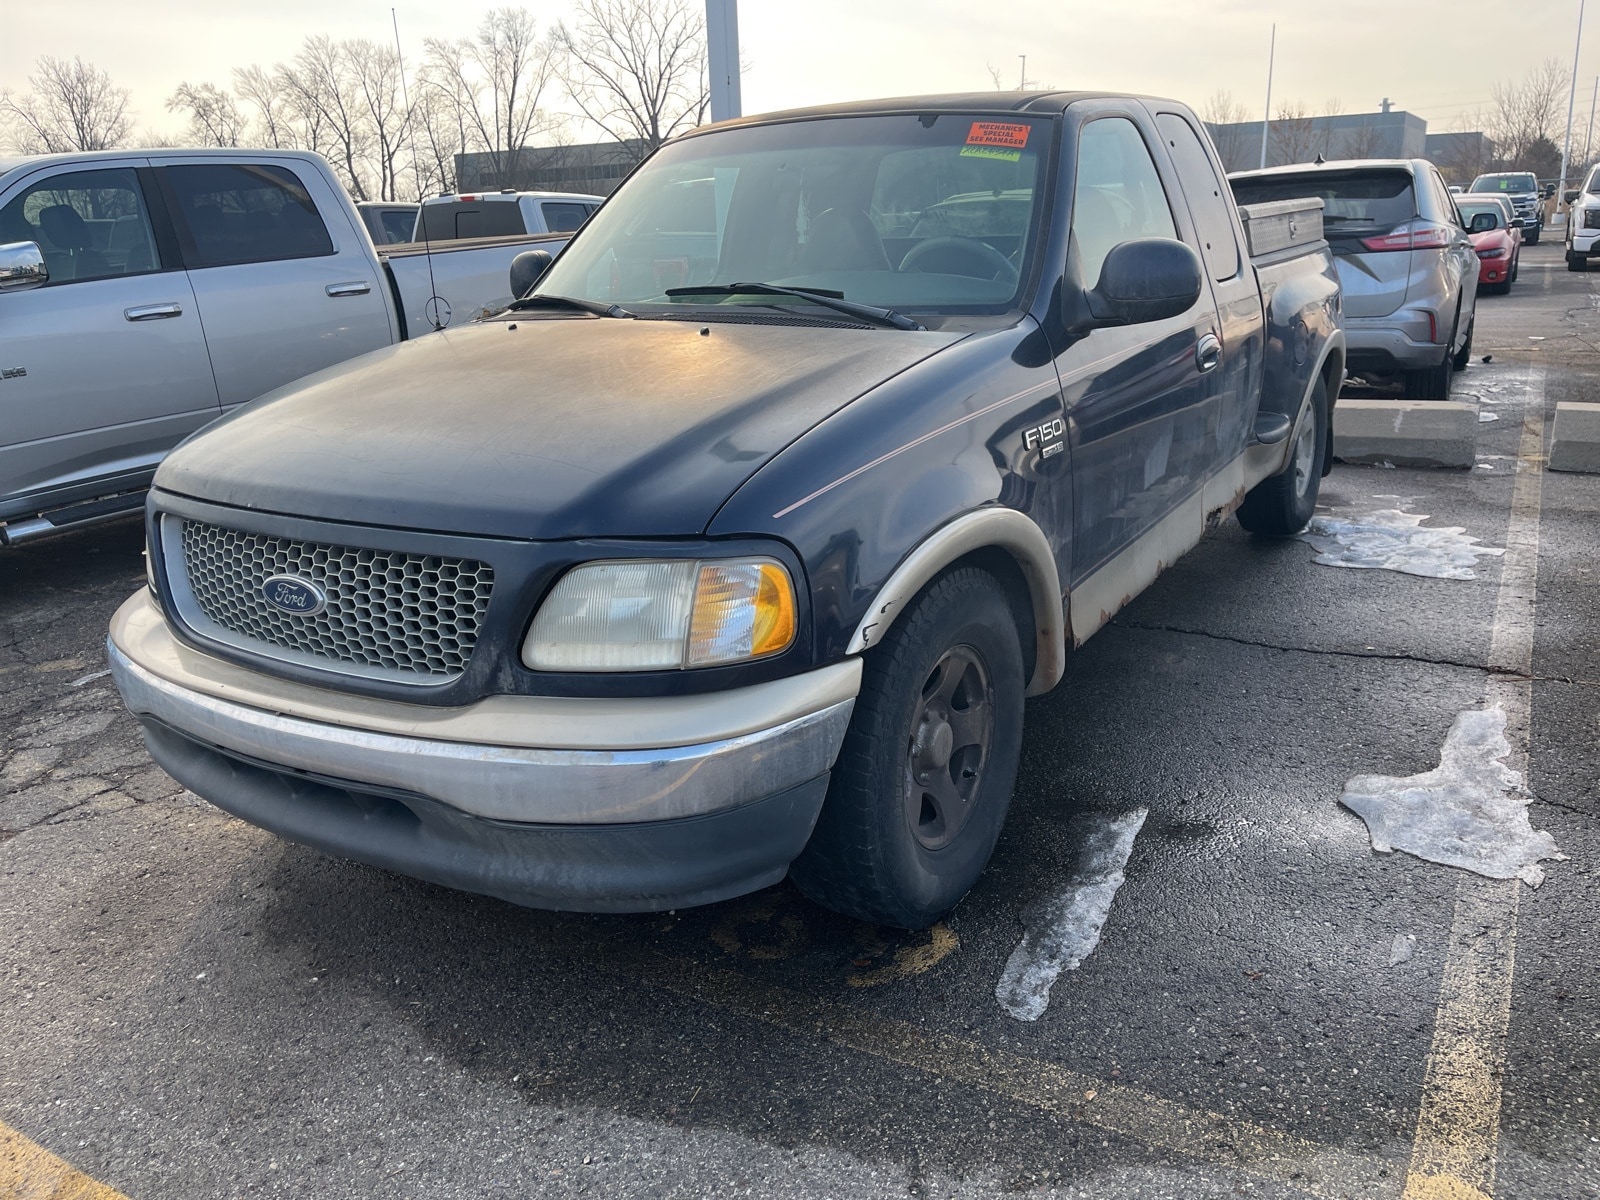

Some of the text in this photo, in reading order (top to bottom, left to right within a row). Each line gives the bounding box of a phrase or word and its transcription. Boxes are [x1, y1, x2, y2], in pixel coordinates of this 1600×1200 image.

[979, 124, 1023, 132] MECHANICS
[983, 130, 1014, 138] SPECIAL
[985, 137, 1024, 145] MANAGER
[274, 582, 307, 608] Ford
